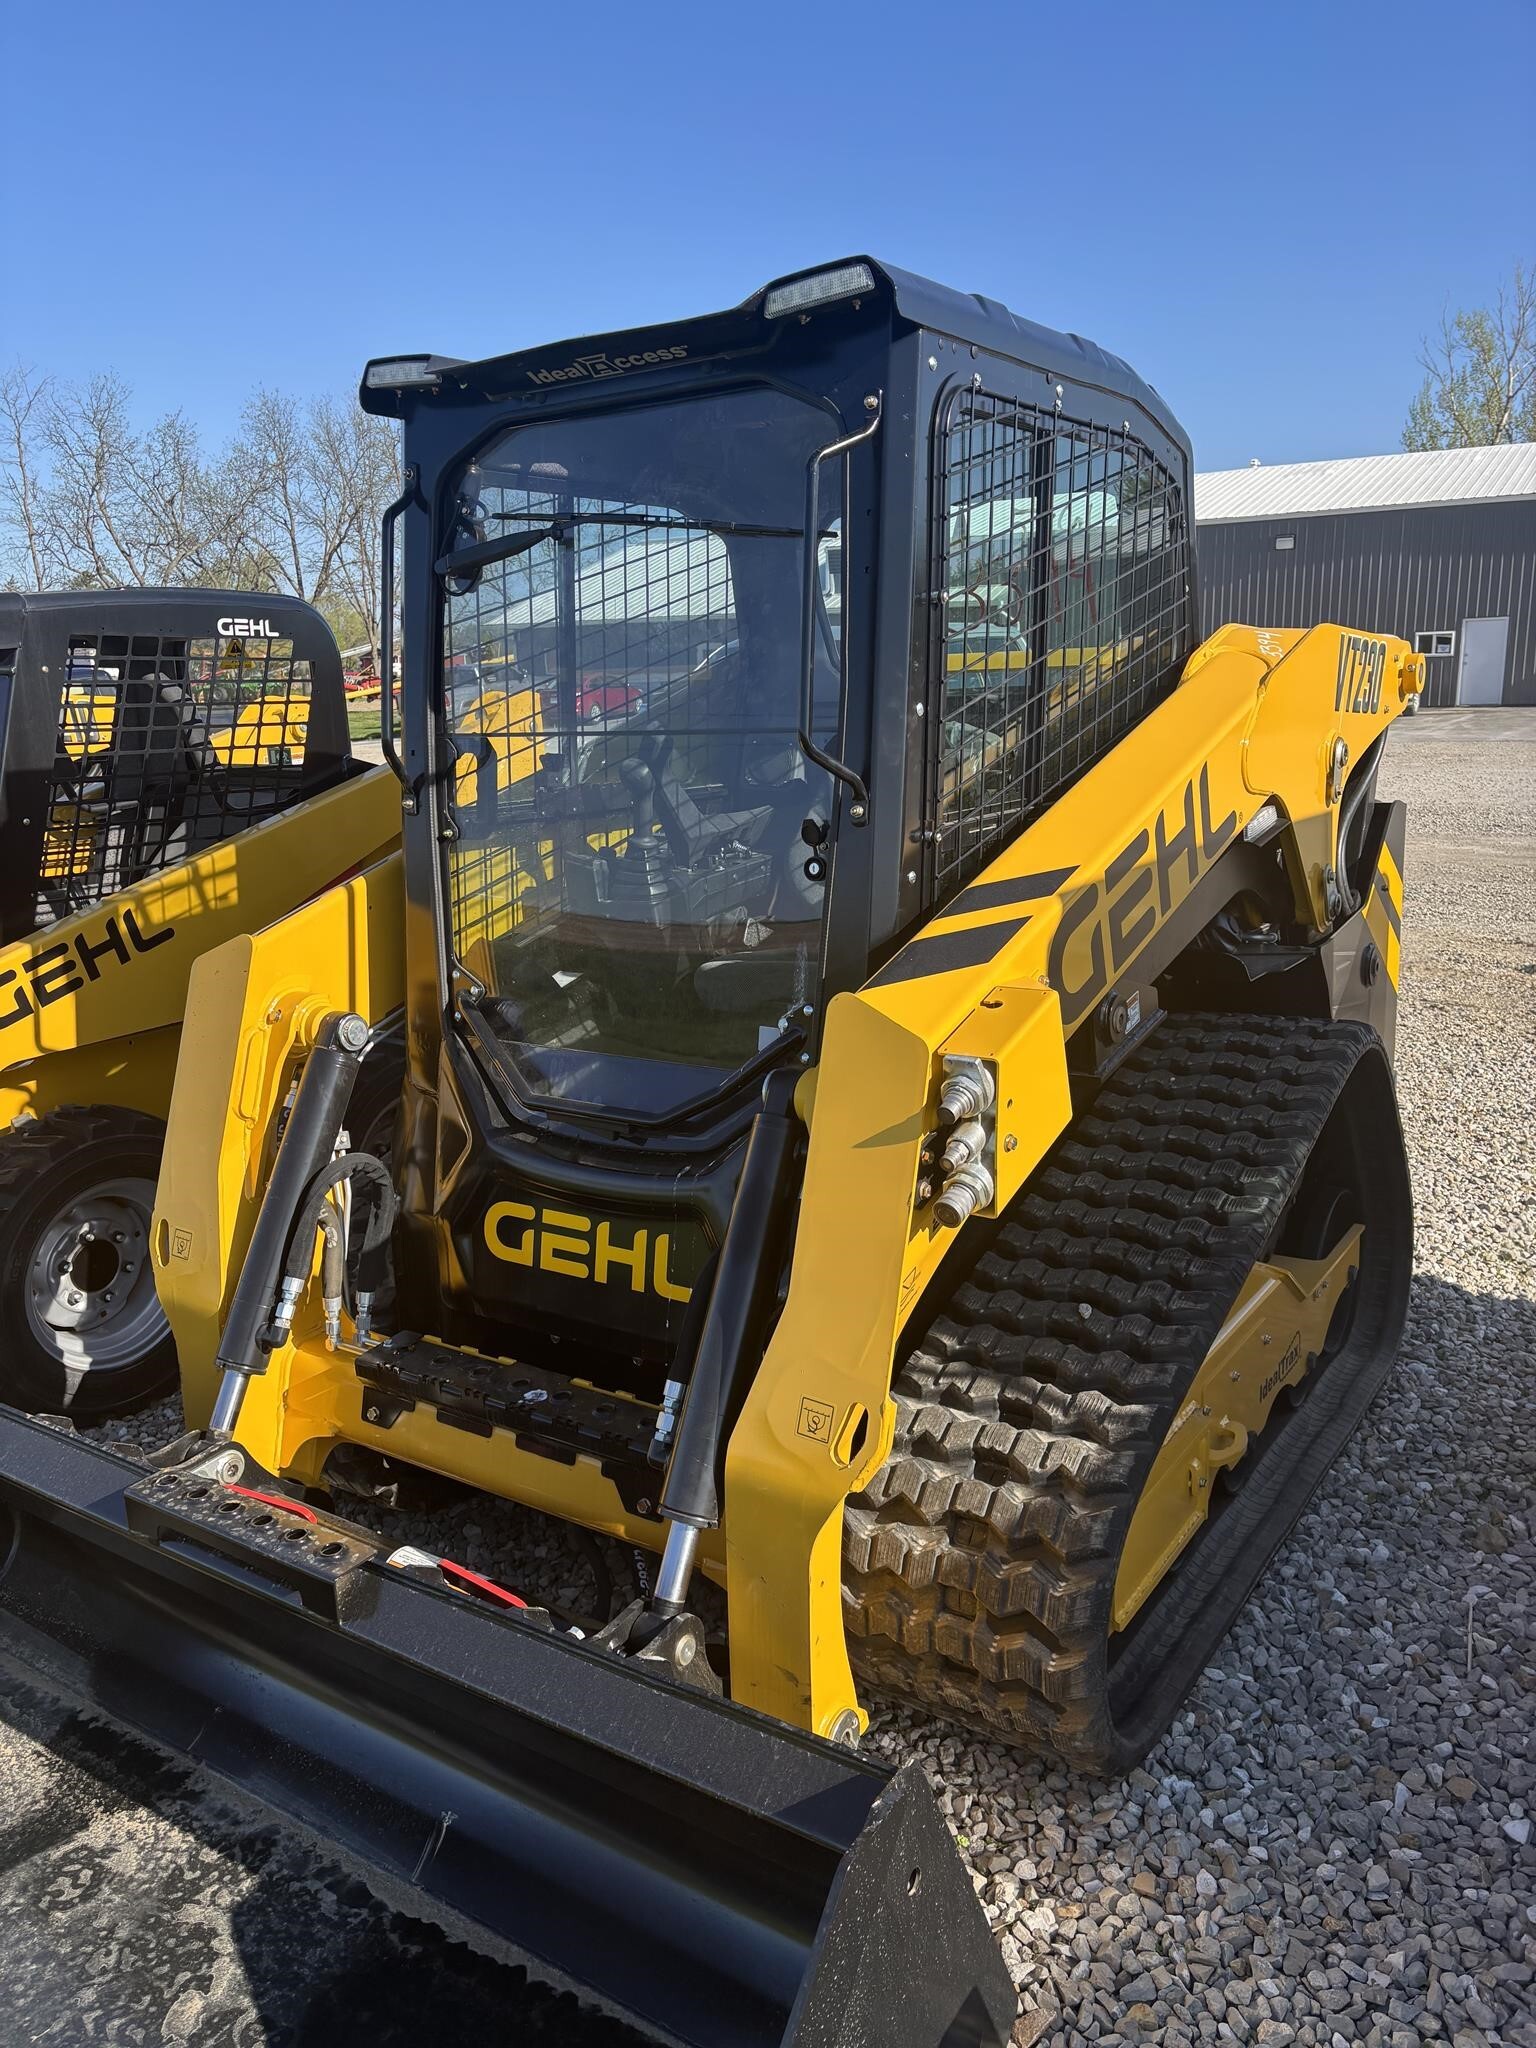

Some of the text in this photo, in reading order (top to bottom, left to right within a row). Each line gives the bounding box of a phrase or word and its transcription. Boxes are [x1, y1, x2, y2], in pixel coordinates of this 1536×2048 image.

[216, 617, 280, 637] GEHL
[1334, 632, 1387, 714] VT230
[1049, 760, 1238, 1026] GEHL
[484, 1200, 693, 1304] GEHL
